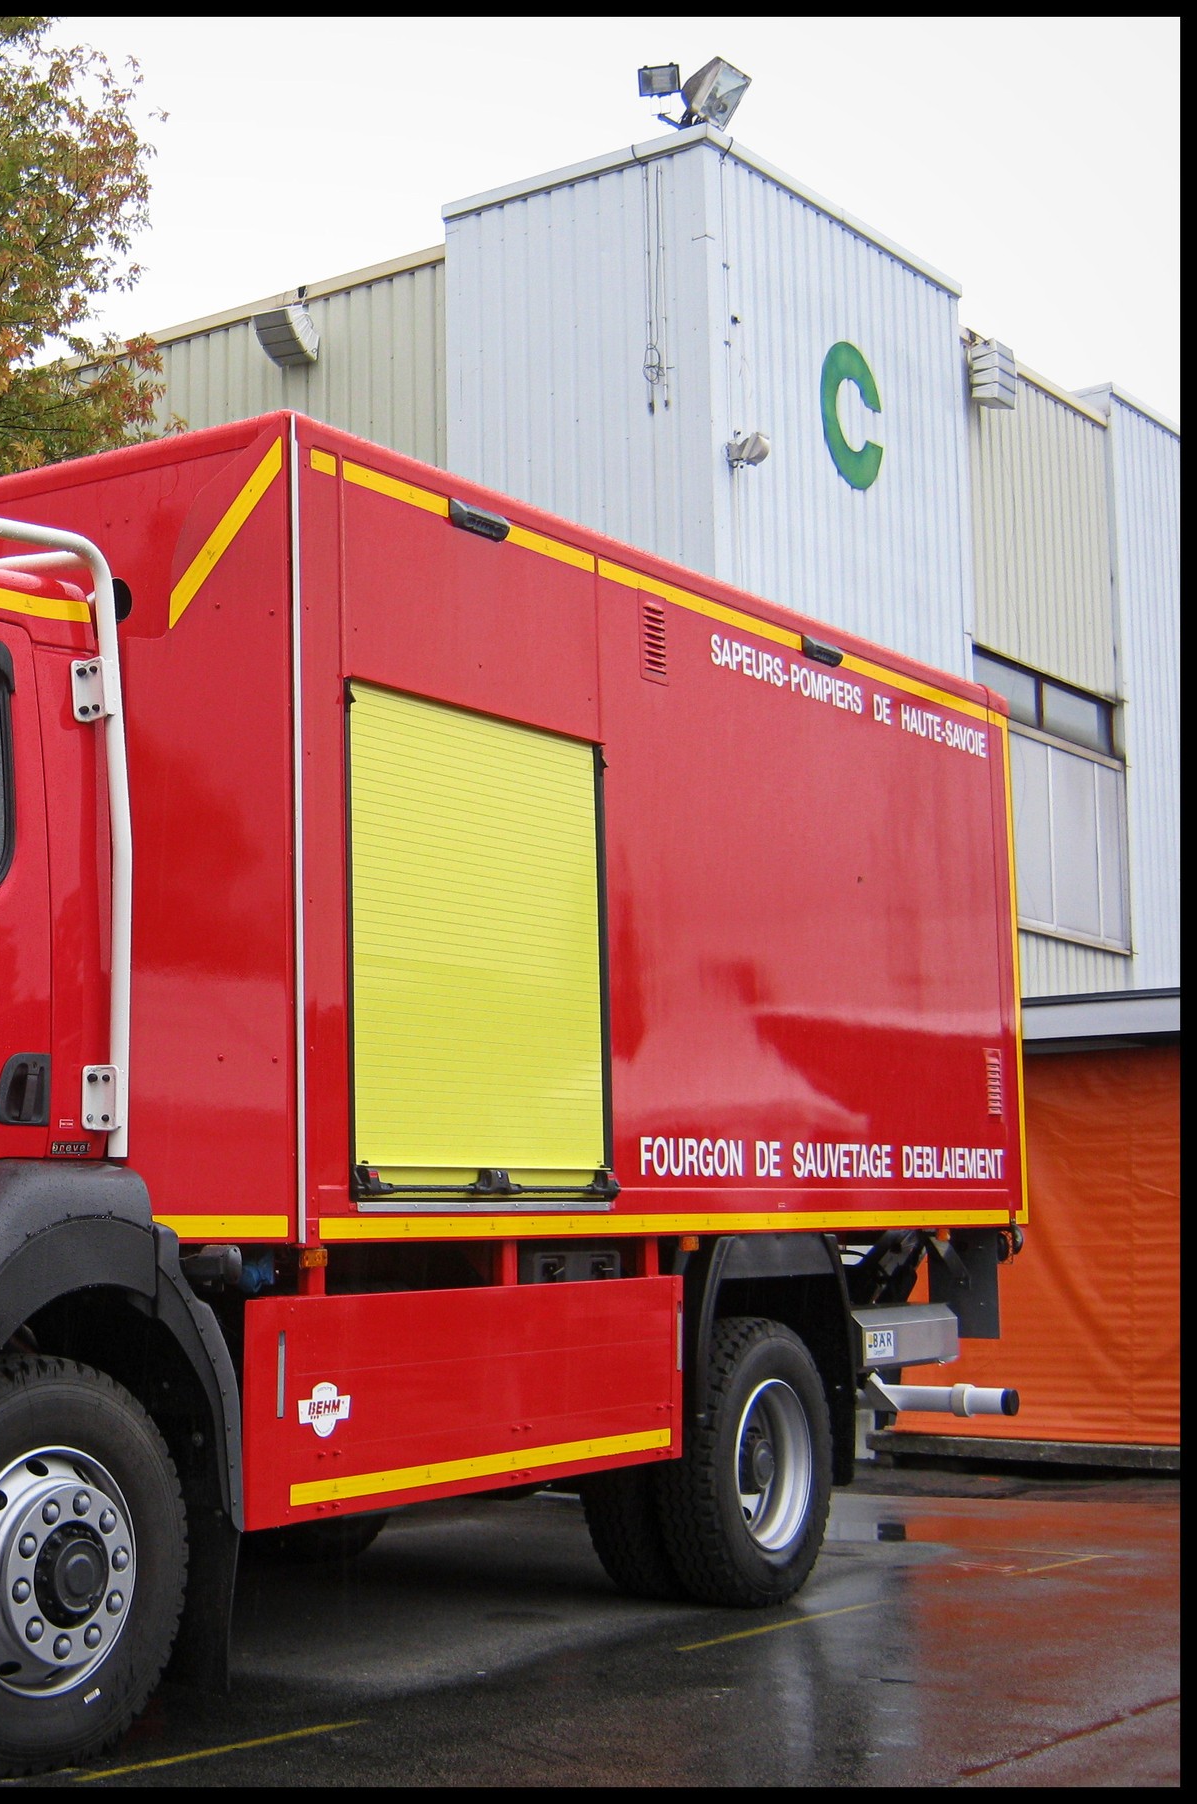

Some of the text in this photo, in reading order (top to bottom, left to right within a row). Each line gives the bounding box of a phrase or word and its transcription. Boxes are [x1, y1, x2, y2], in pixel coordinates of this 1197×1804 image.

[820, 340, 884, 491] C
[710, 634, 987, 759] SAPEURS-POMPIERS DE HAUTE-SAVOIE
[640, 1137, 1005, 1179] FOURGON DE SAUVETAGE DEBLAIEMENT
[873, 1332, 893, 1348] BÄR
